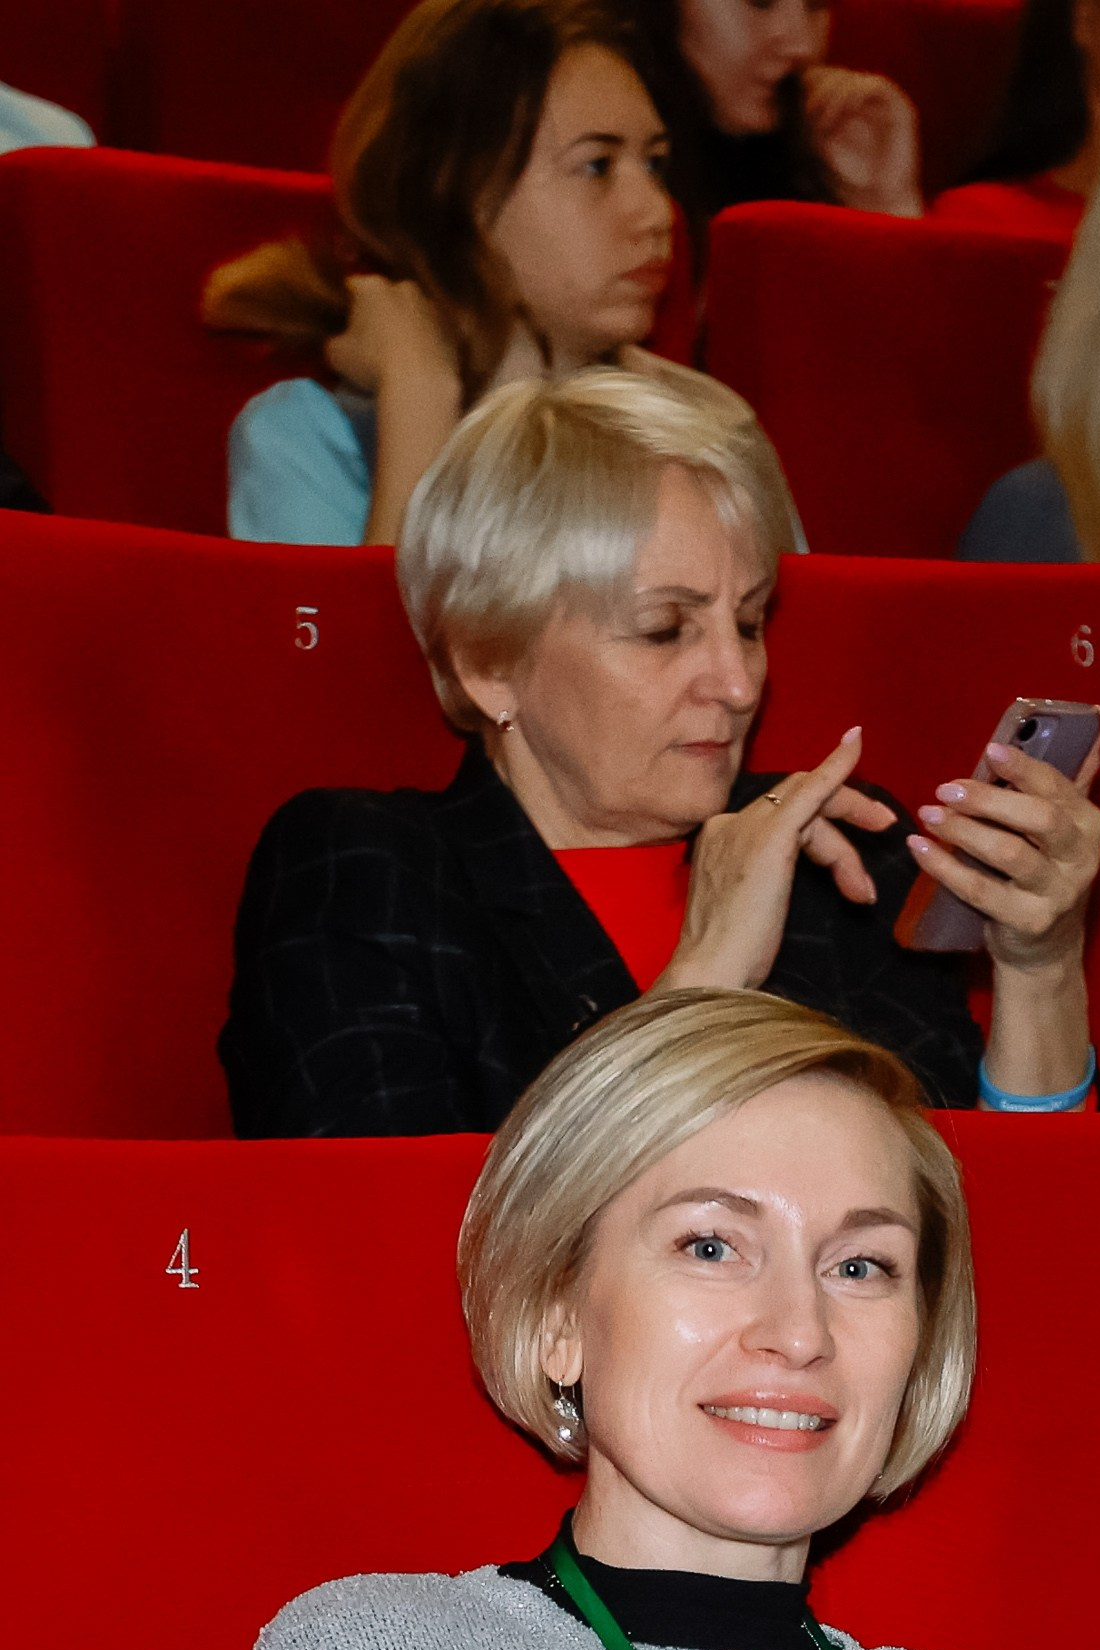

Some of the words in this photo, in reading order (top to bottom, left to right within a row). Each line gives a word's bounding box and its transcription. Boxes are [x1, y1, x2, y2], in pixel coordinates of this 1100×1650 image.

[294, 606, 320, 650] 5
[1070, 624, 1095, 668] 6
[165, 1228, 200, 1289] 4
